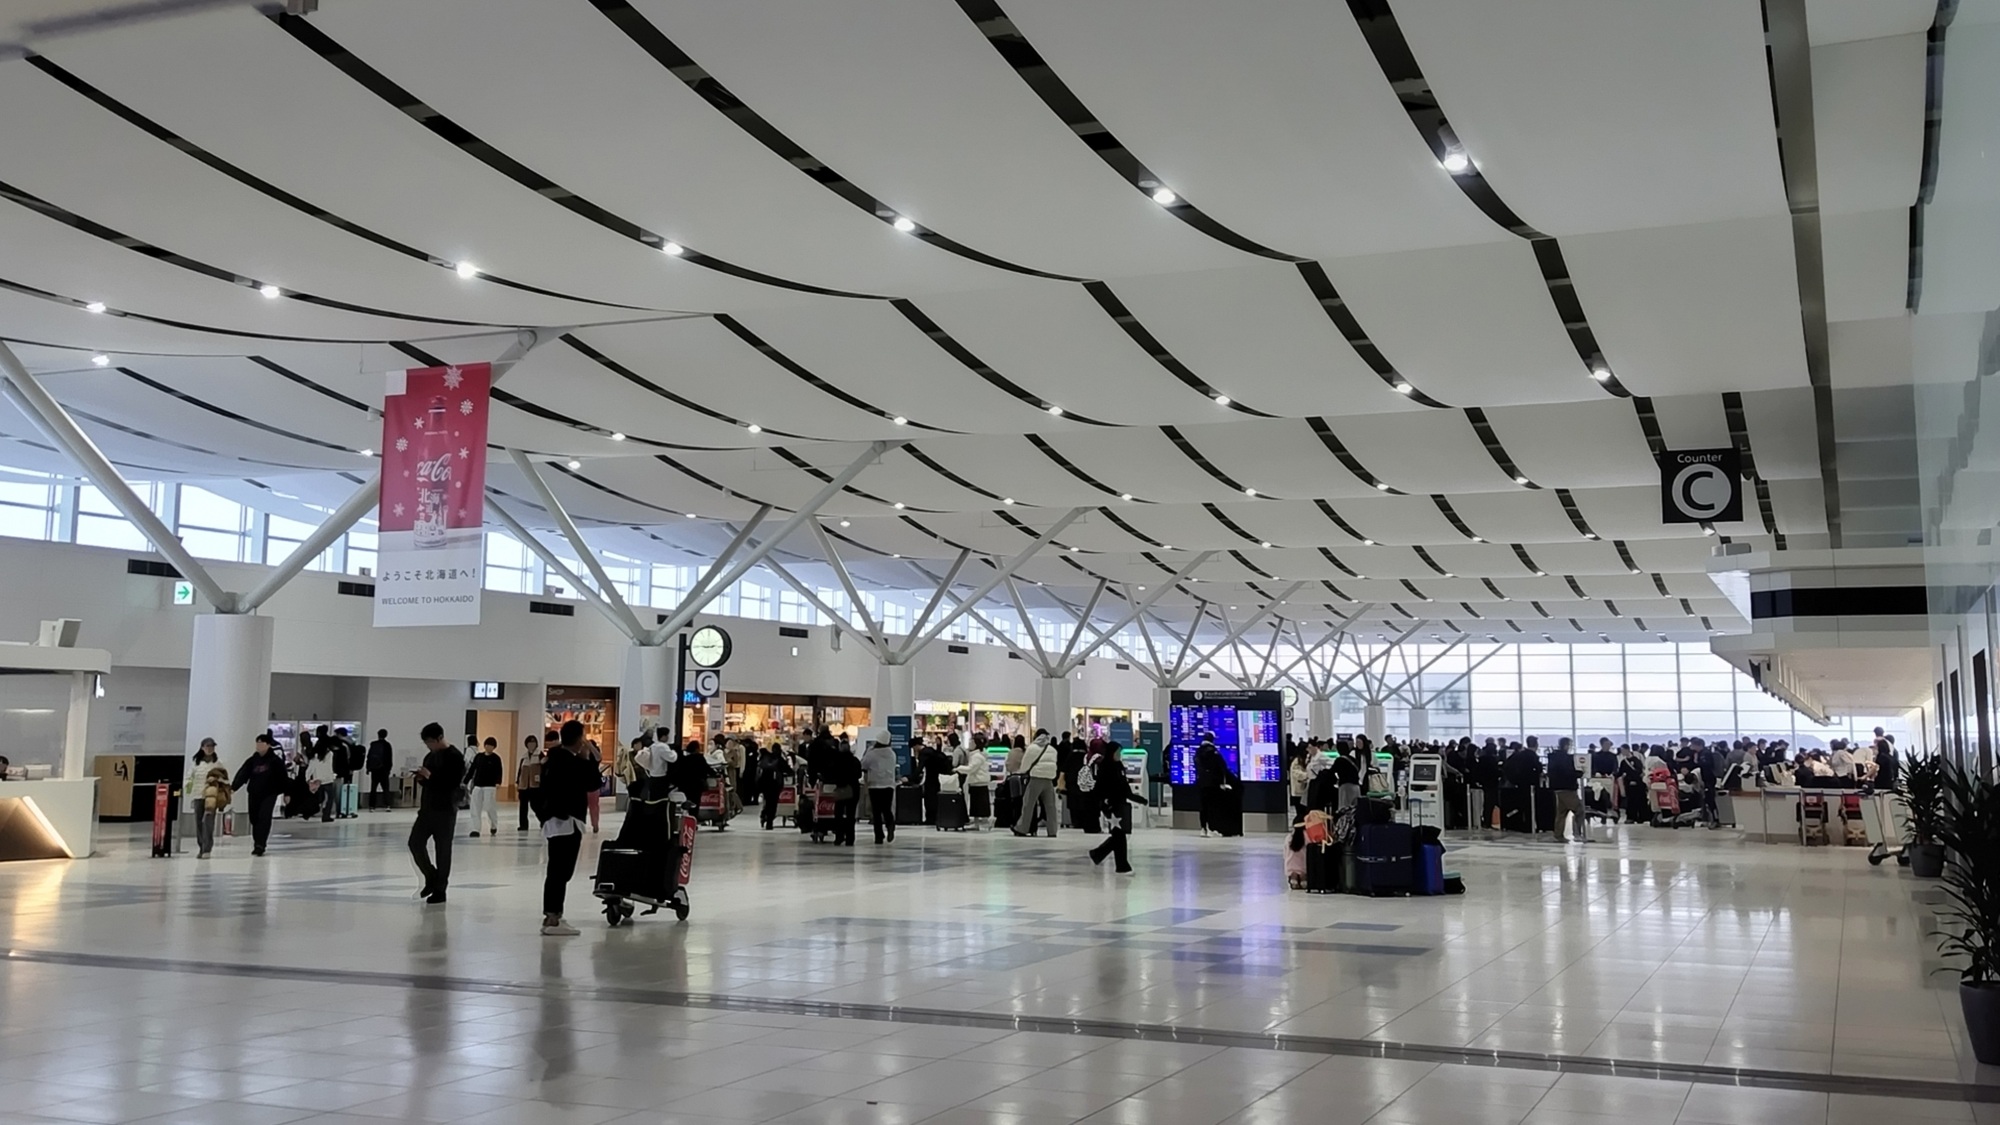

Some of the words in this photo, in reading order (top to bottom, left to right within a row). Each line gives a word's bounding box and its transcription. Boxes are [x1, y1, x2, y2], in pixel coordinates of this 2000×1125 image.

[1677, 453, 1723, 463] Counter
[1682, 471, 1715, 511] C
[382, 568, 476, 582] ようこそ北海道へ!
[381, 596, 420, 605] WELCOME
[421, 596, 432, 604] TO
[433, 595, 474, 604] HOKKAIDO
[701, 675, 713, 691] C
